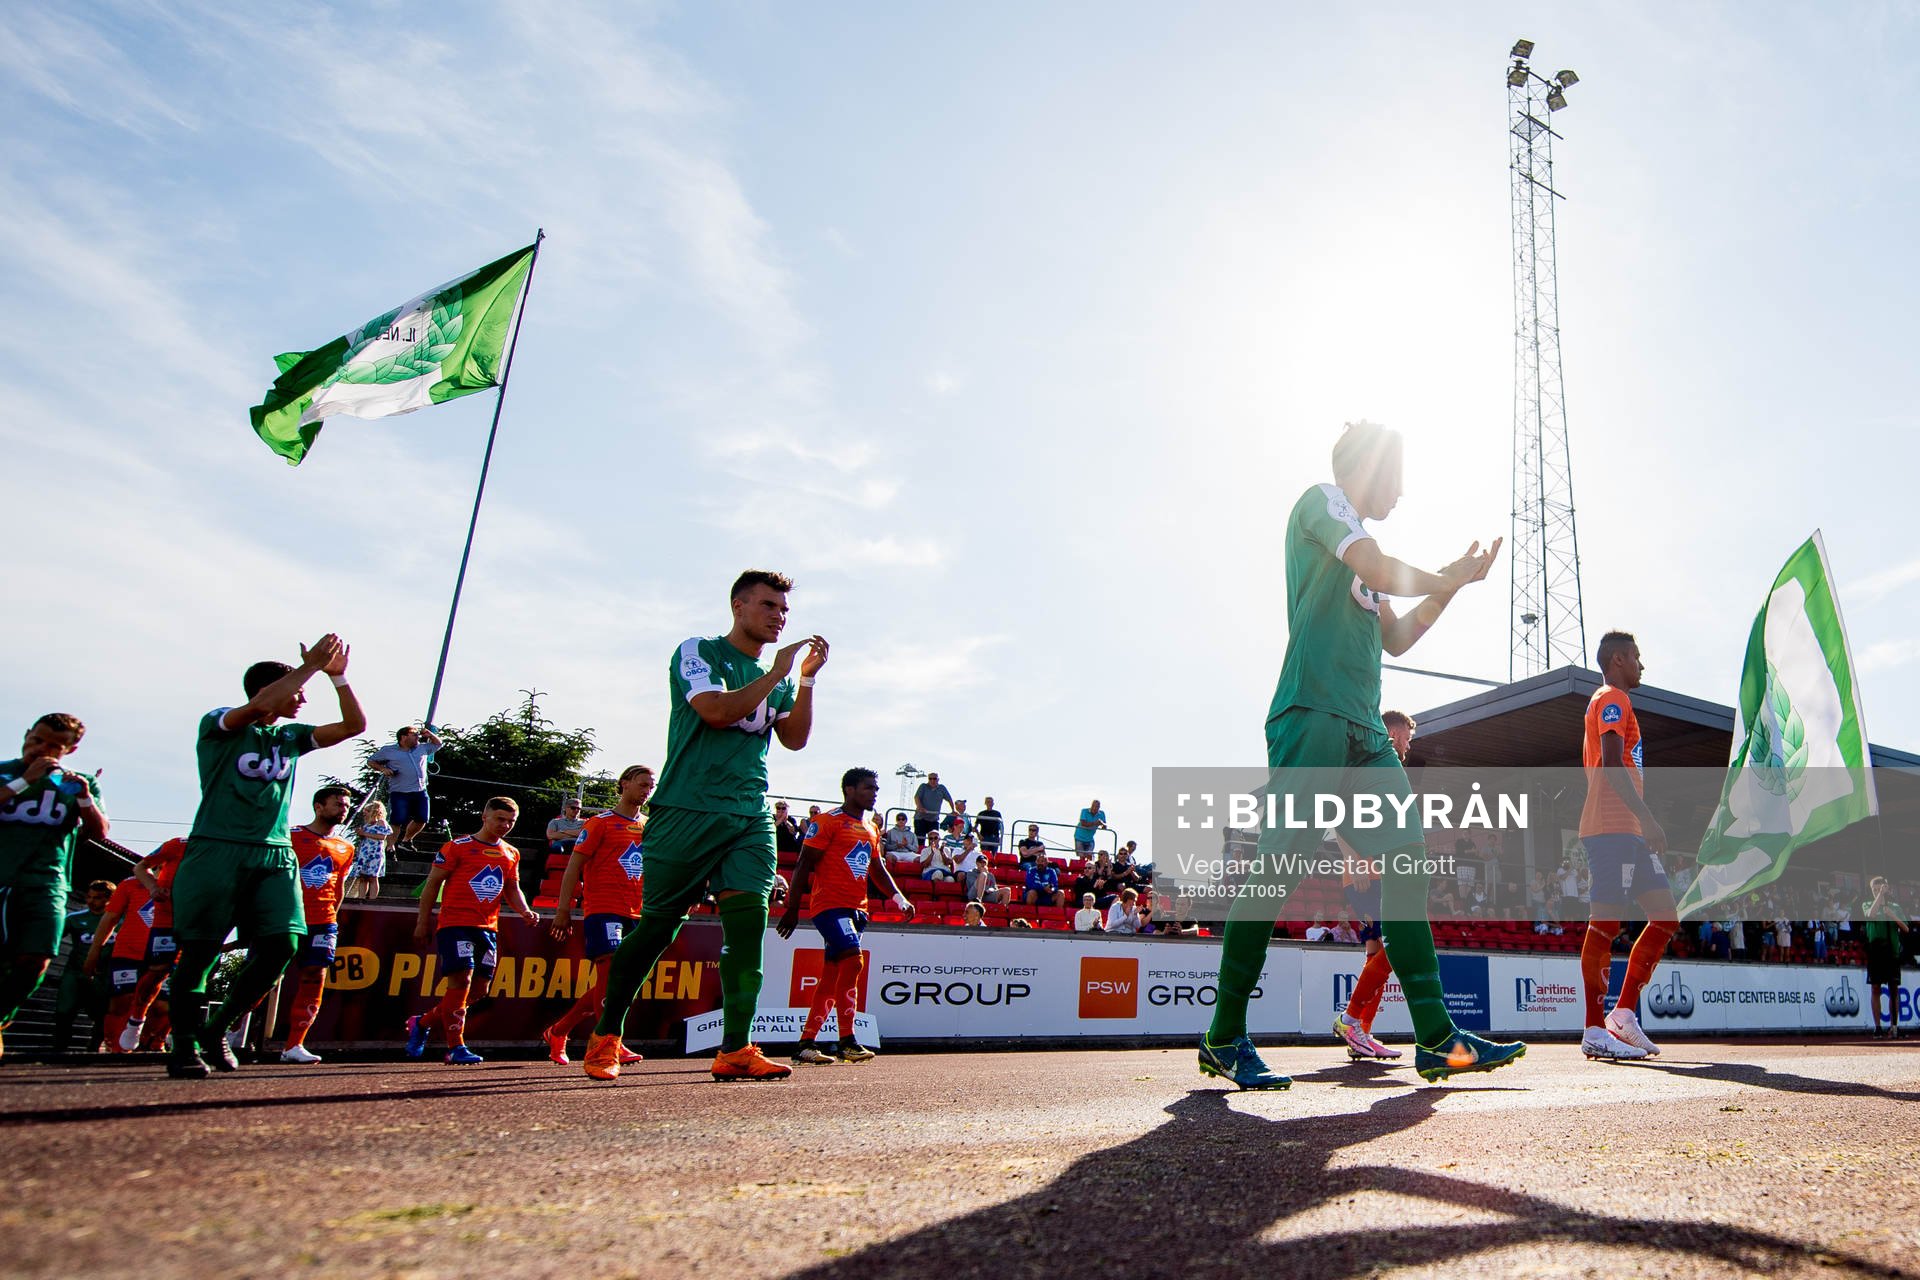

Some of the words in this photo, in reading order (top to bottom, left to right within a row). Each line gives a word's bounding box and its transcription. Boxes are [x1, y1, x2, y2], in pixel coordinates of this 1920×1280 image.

[685, 667, 708, 677] OBOS
[329, 953, 364, 984] PB
[881, 964, 931, 975] PETRO
[934, 965, 999, 976] SUPPORT
[1002, 966, 1039, 977] WEST
[1148, 970, 1186, 979] PETRO
[1188, 971, 1220, 980] SUPP
[388, 953, 703, 999] PIABAKEN
[880, 981, 1031, 1006] GROUP
[1087, 981, 1131, 995] PSW
[1516, 977, 1576, 1002] Maritime
[1148, 985, 1264, 1006] GROP
[1527, 994, 1577, 1003] Construction
[1702, 990, 1736, 1004] COAST
[1739, 991, 1777, 1004] CENTER
[1778, 991, 1801, 1004] BASE
[1803, 992, 1815, 1004] AS
[1519, 1003, 1557, 1013] Solutions
[770, 1025, 796, 1033] ALL
